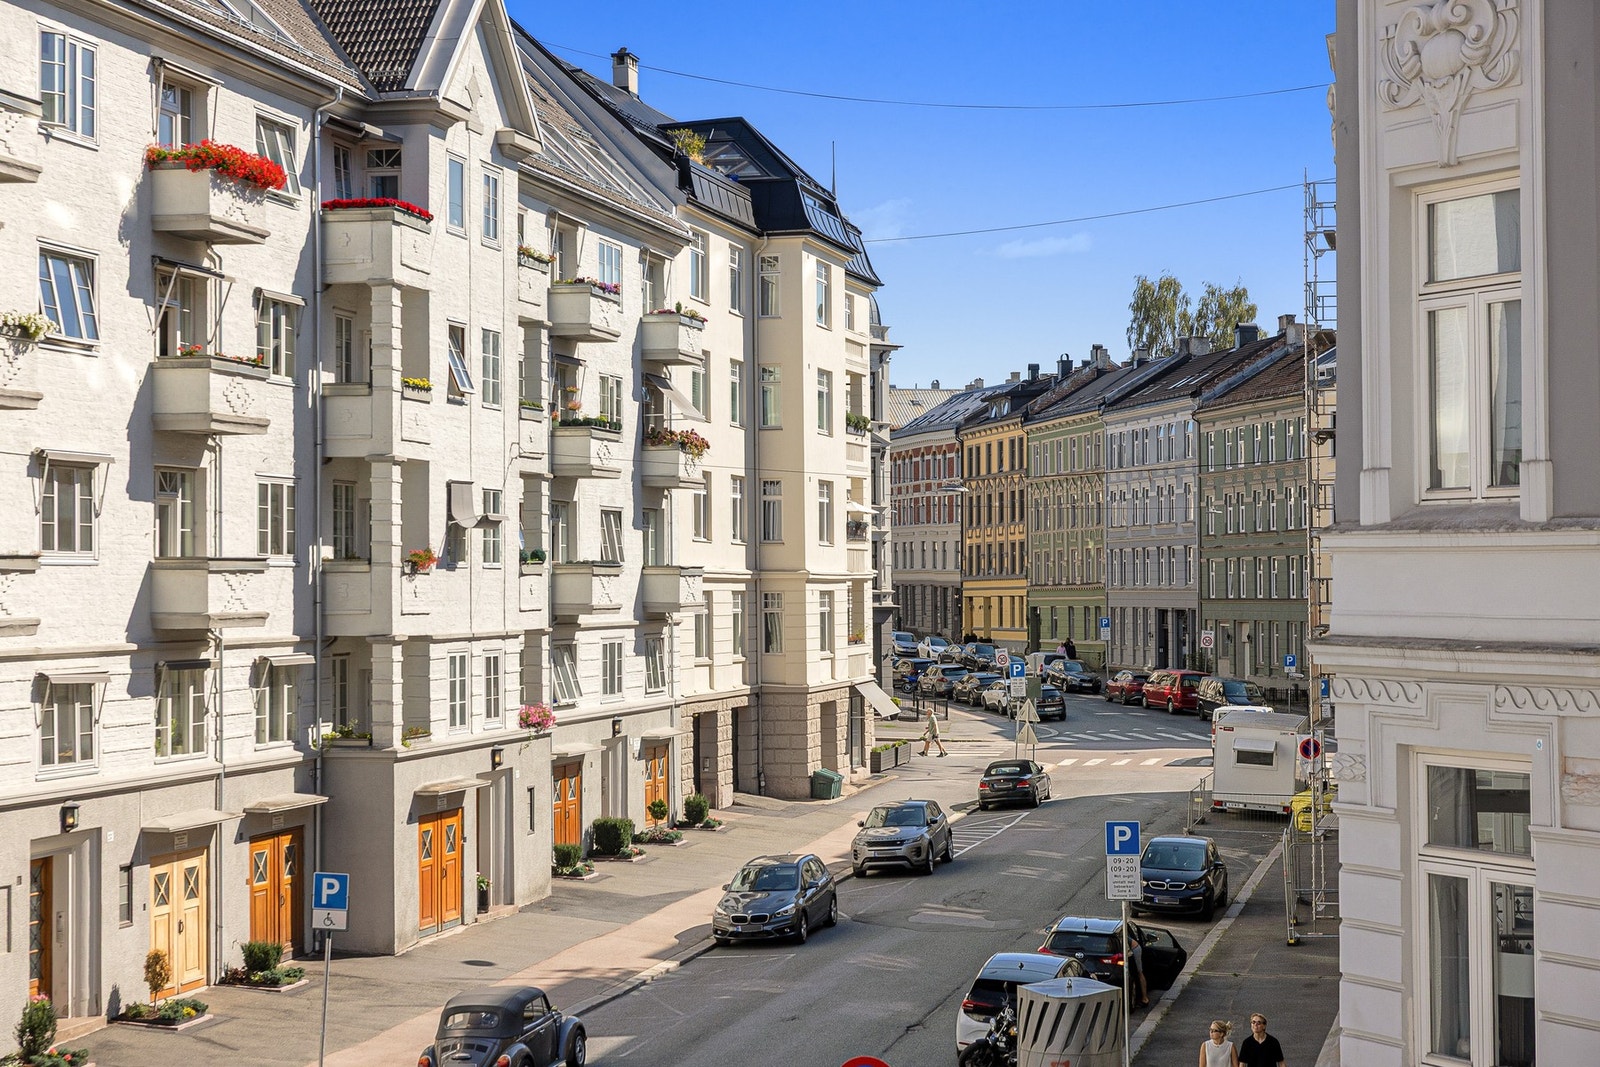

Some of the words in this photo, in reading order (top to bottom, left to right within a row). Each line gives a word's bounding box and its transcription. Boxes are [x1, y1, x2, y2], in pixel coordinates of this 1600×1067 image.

[1287, 656, 1293, 665] P
[1014, 664, 1021, 676] P
[1114, 826, 1132, 851] P
[321, 878, 340, 904] P
